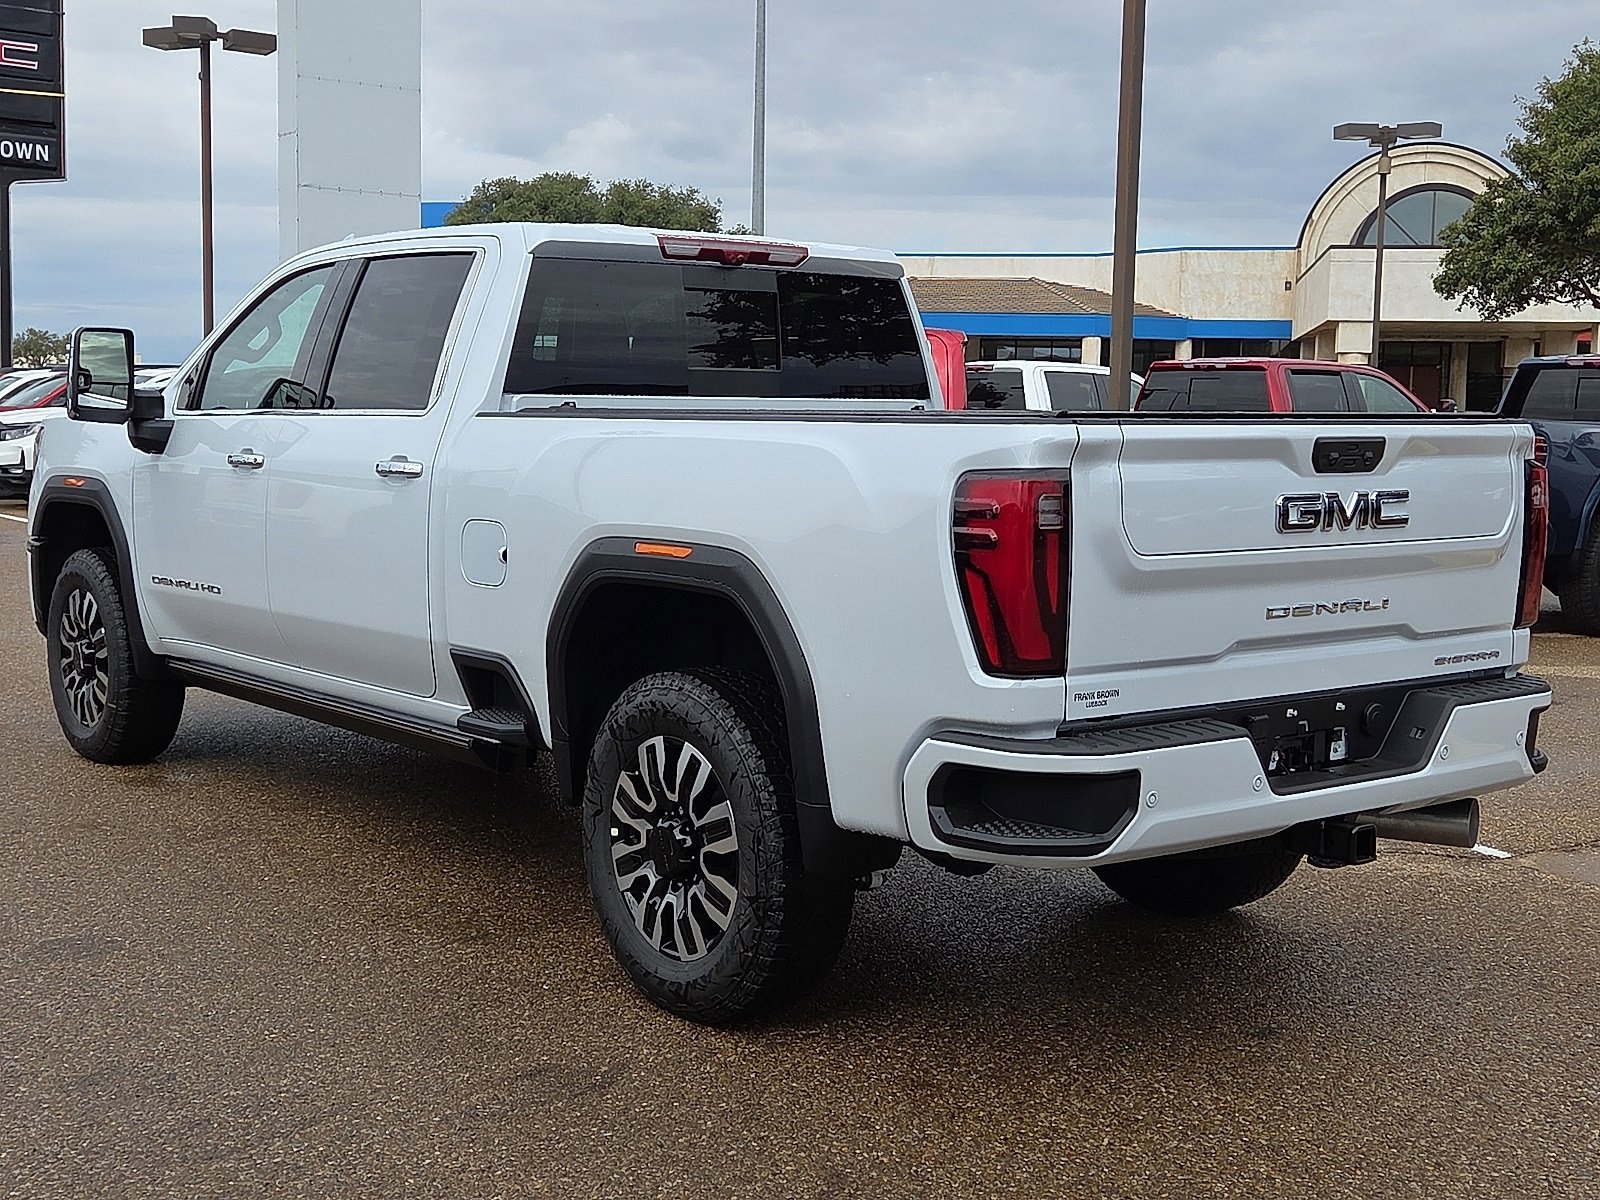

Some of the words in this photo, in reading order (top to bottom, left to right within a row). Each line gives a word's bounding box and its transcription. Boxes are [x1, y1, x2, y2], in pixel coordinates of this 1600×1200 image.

[1275, 489, 1410, 534] GMC
[151, 576, 200, 591] DENALI
[201, 583, 222, 595] HD
[1265, 597, 1390, 621] DENALI
[1434, 650, 1500, 666] SIERRA
